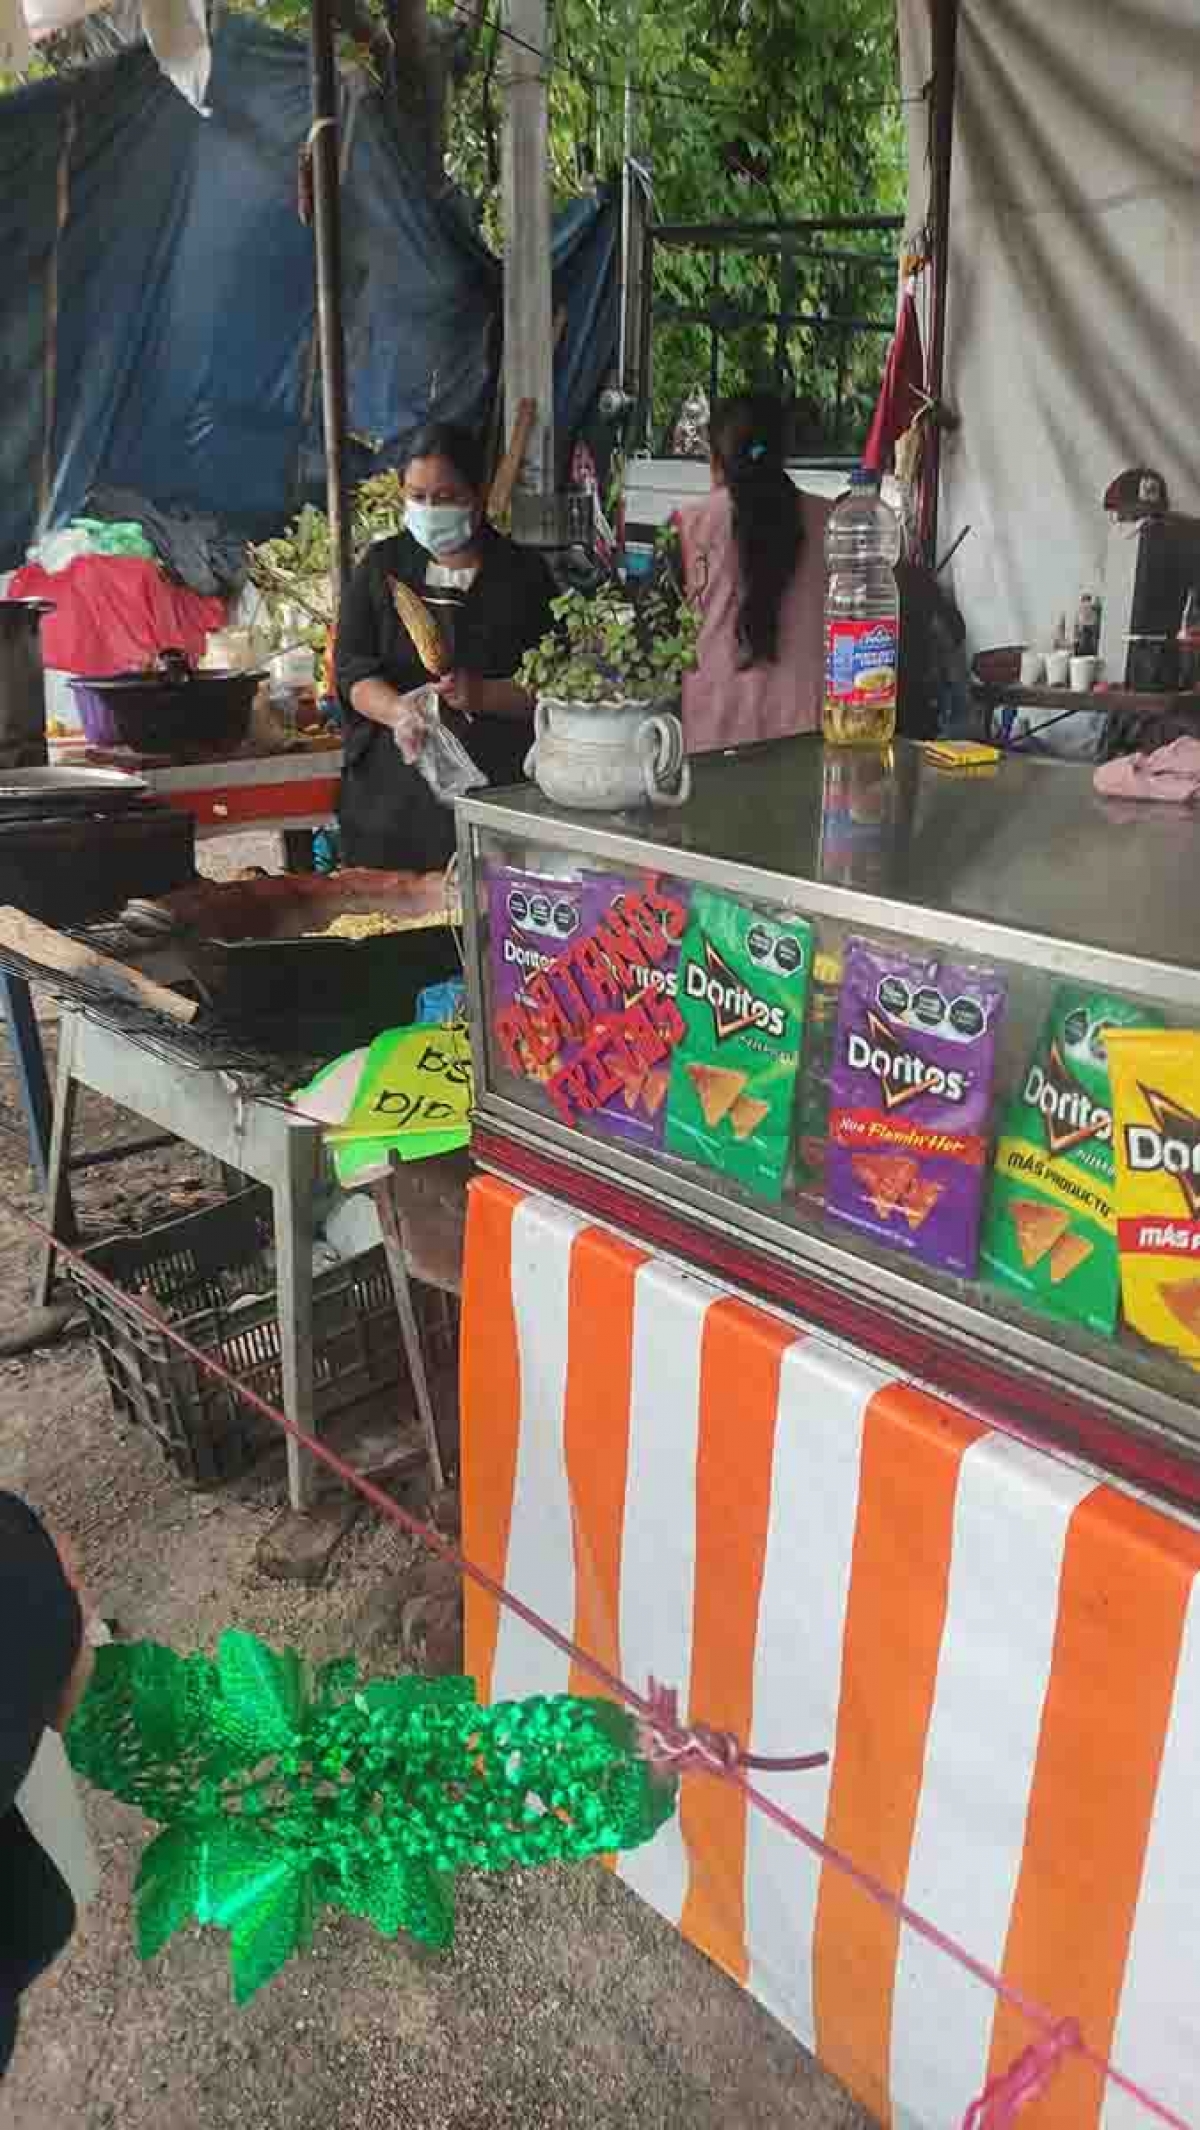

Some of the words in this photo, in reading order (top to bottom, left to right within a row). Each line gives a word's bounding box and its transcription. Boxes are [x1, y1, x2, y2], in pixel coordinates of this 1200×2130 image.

[686, 962, 785, 1036] Doritos
[847, 1034, 966, 1101] Doritos
[1023, 1065, 1112, 1141] Dorito
